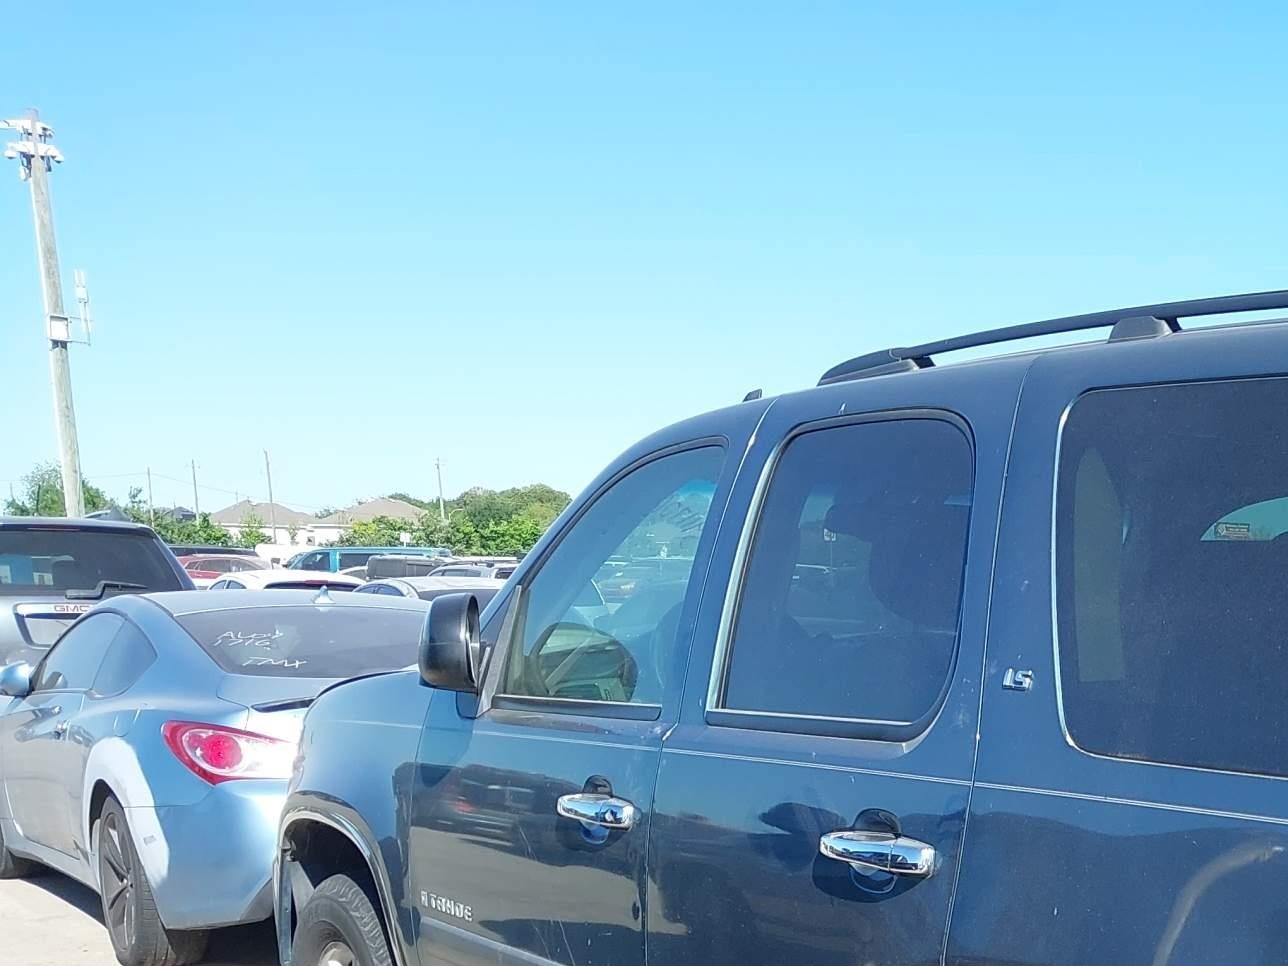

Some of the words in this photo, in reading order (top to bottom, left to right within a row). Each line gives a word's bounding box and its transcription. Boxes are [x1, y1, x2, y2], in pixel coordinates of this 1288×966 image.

[54, 605, 90, 613] GMC
[1002, 668, 1034, 691] LS
[430, 893, 473, 922] TAHOE
